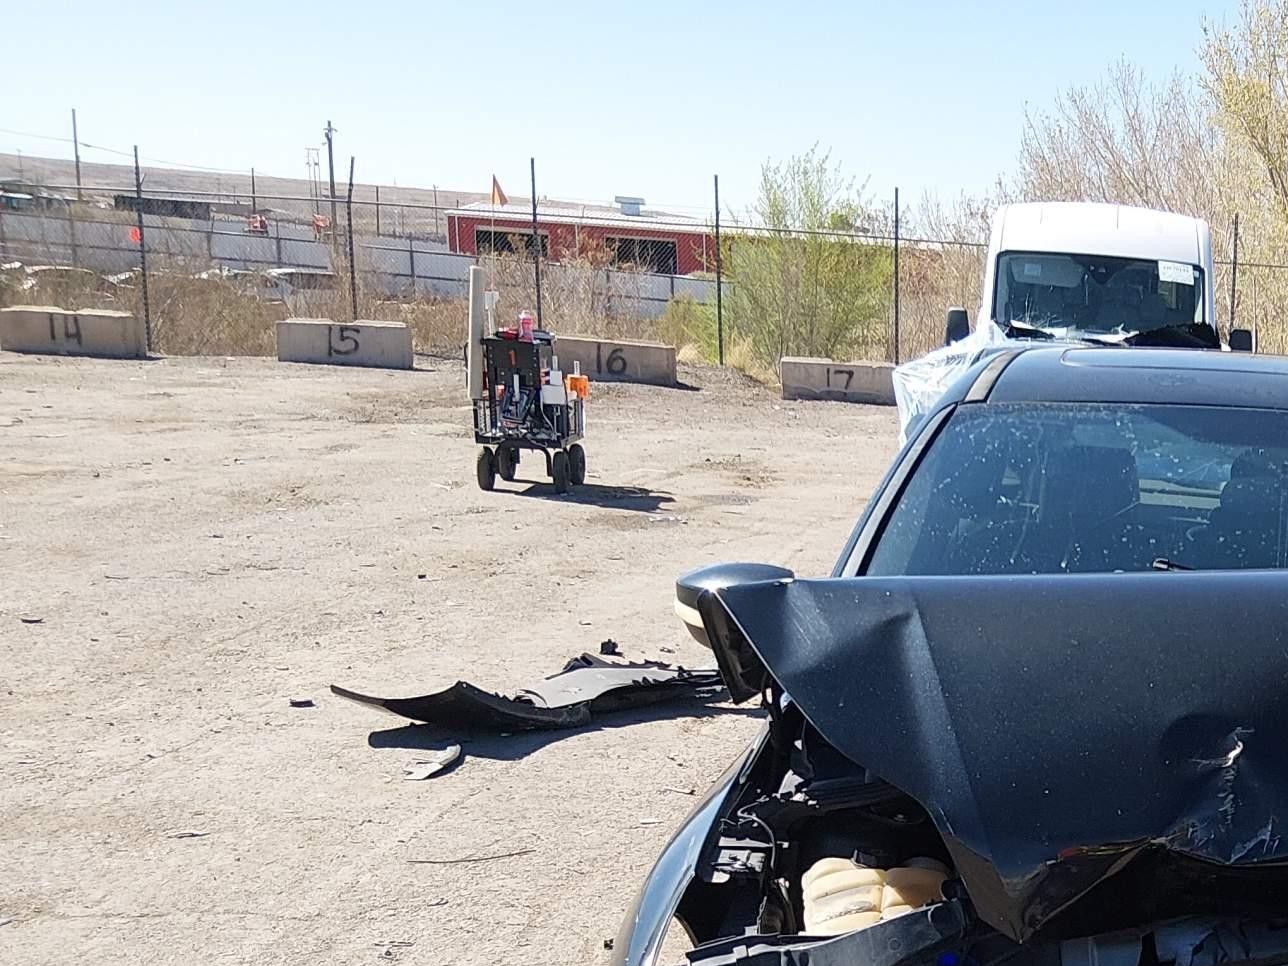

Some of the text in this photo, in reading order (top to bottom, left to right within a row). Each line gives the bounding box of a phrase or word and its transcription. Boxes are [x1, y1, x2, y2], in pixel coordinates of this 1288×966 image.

[49, 313, 82, 346] 14
[328, 325, 360, 356] 15
[596, 342, 627, 375] 16
[826, 367, 854, 390] 17
